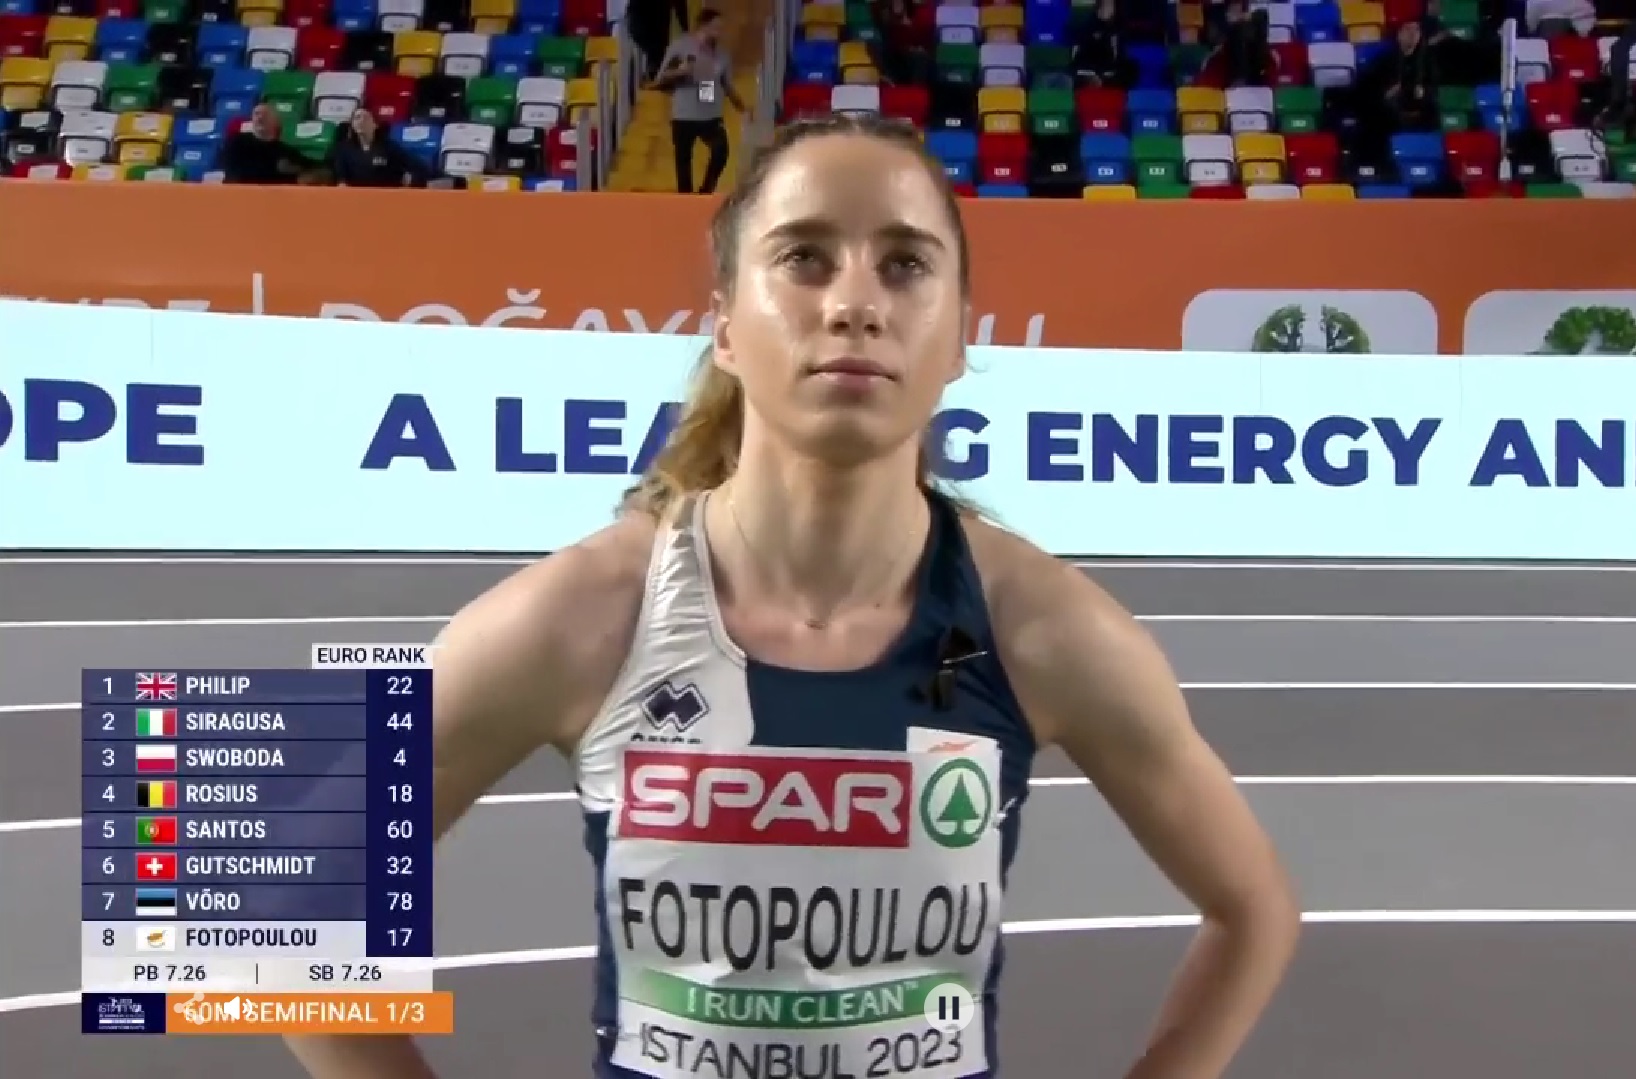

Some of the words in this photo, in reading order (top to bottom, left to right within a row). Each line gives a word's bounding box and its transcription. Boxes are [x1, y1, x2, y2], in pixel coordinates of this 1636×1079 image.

[360, 393, 457, 472] A
[1028, 411, 1442, 487] ENERGY
[630, 764, 904, 834] SPAR
[619, 878, 989, 971] FOTOPOULOU
[686, 986, 696, 1013] I
[704, 992, 782, 1022] RUN
[640, 1022, 856, 1079] ISTANBUL
[866, 1023, 962, 1078] 2023
